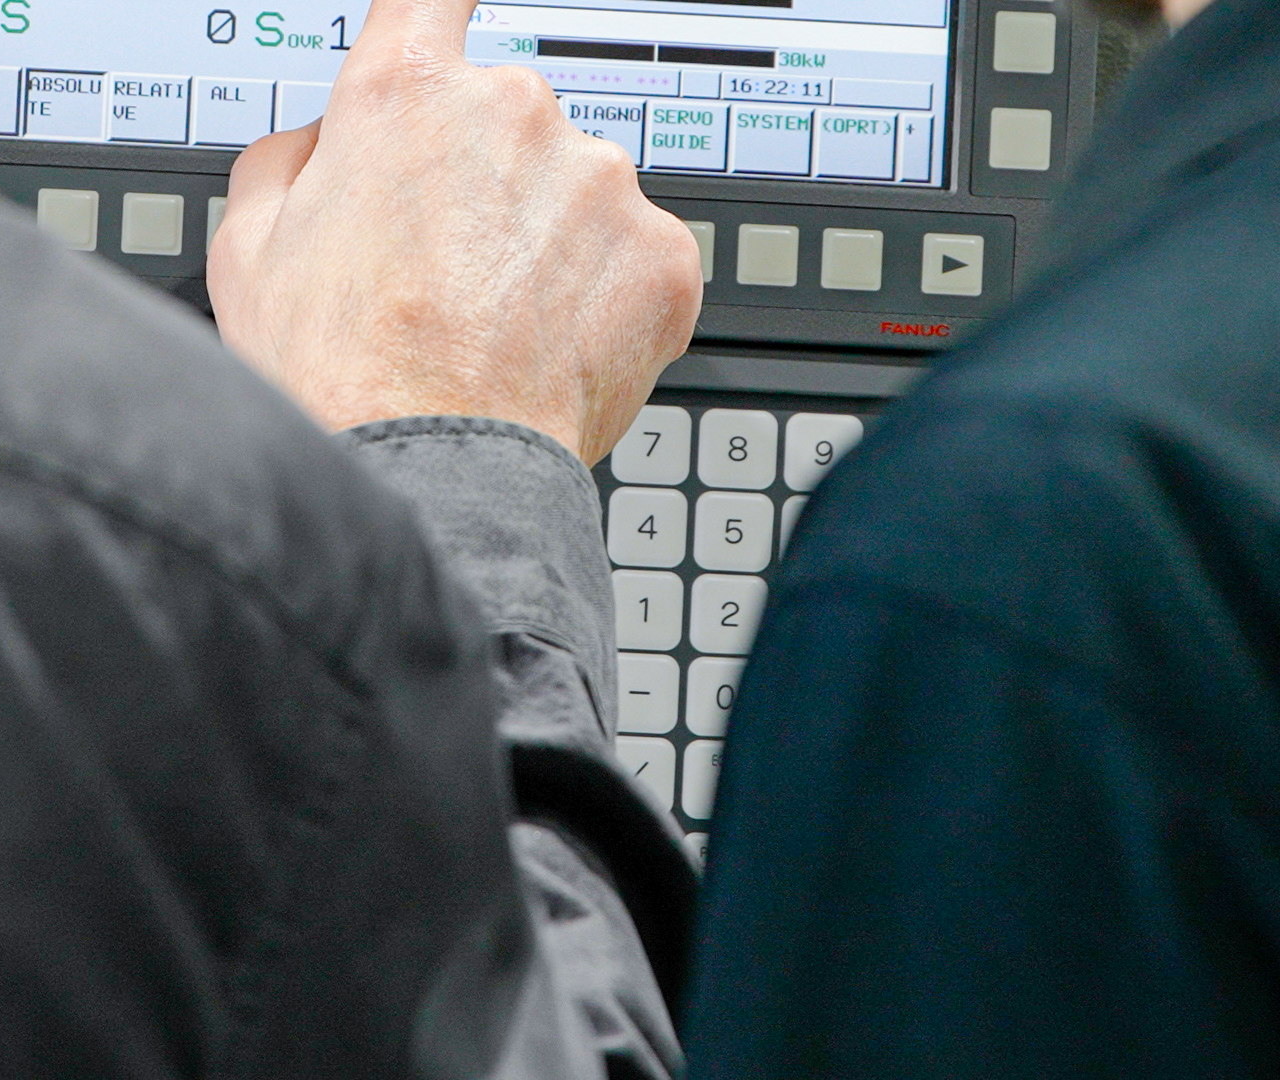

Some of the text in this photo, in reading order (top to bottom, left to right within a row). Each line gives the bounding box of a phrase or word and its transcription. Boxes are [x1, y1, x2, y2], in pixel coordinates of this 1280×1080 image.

[207, 8, 237, 44] 0
[497, 37, 533, 53] -30
[778, 52, 826, 69] 30kW
[28, 76, 102, 95] ABSOLU
[114, 80, 183, 99] RELATI
[211, 85, 246, 102] ALL
[730, 78, 824, 97] 16:22:11
[28, 100, 51, 117] TE
[113, 105, 137, 121] VE
[570, 104, 641, 122] DIAGNO
[653, 108, 714, 126] SERVO
[737, 113, 809, 131] SYSTEM
[822, 117, 892, 136] (OPRT)
[652, 132, 712, 151] GUIDE
[878, 320, 951, 338] FANUC
[642, 431, 833, 465] 7 8 9
[637, 514, 743, 544] 4 5
[638, 597, 740, 627] 1 2
